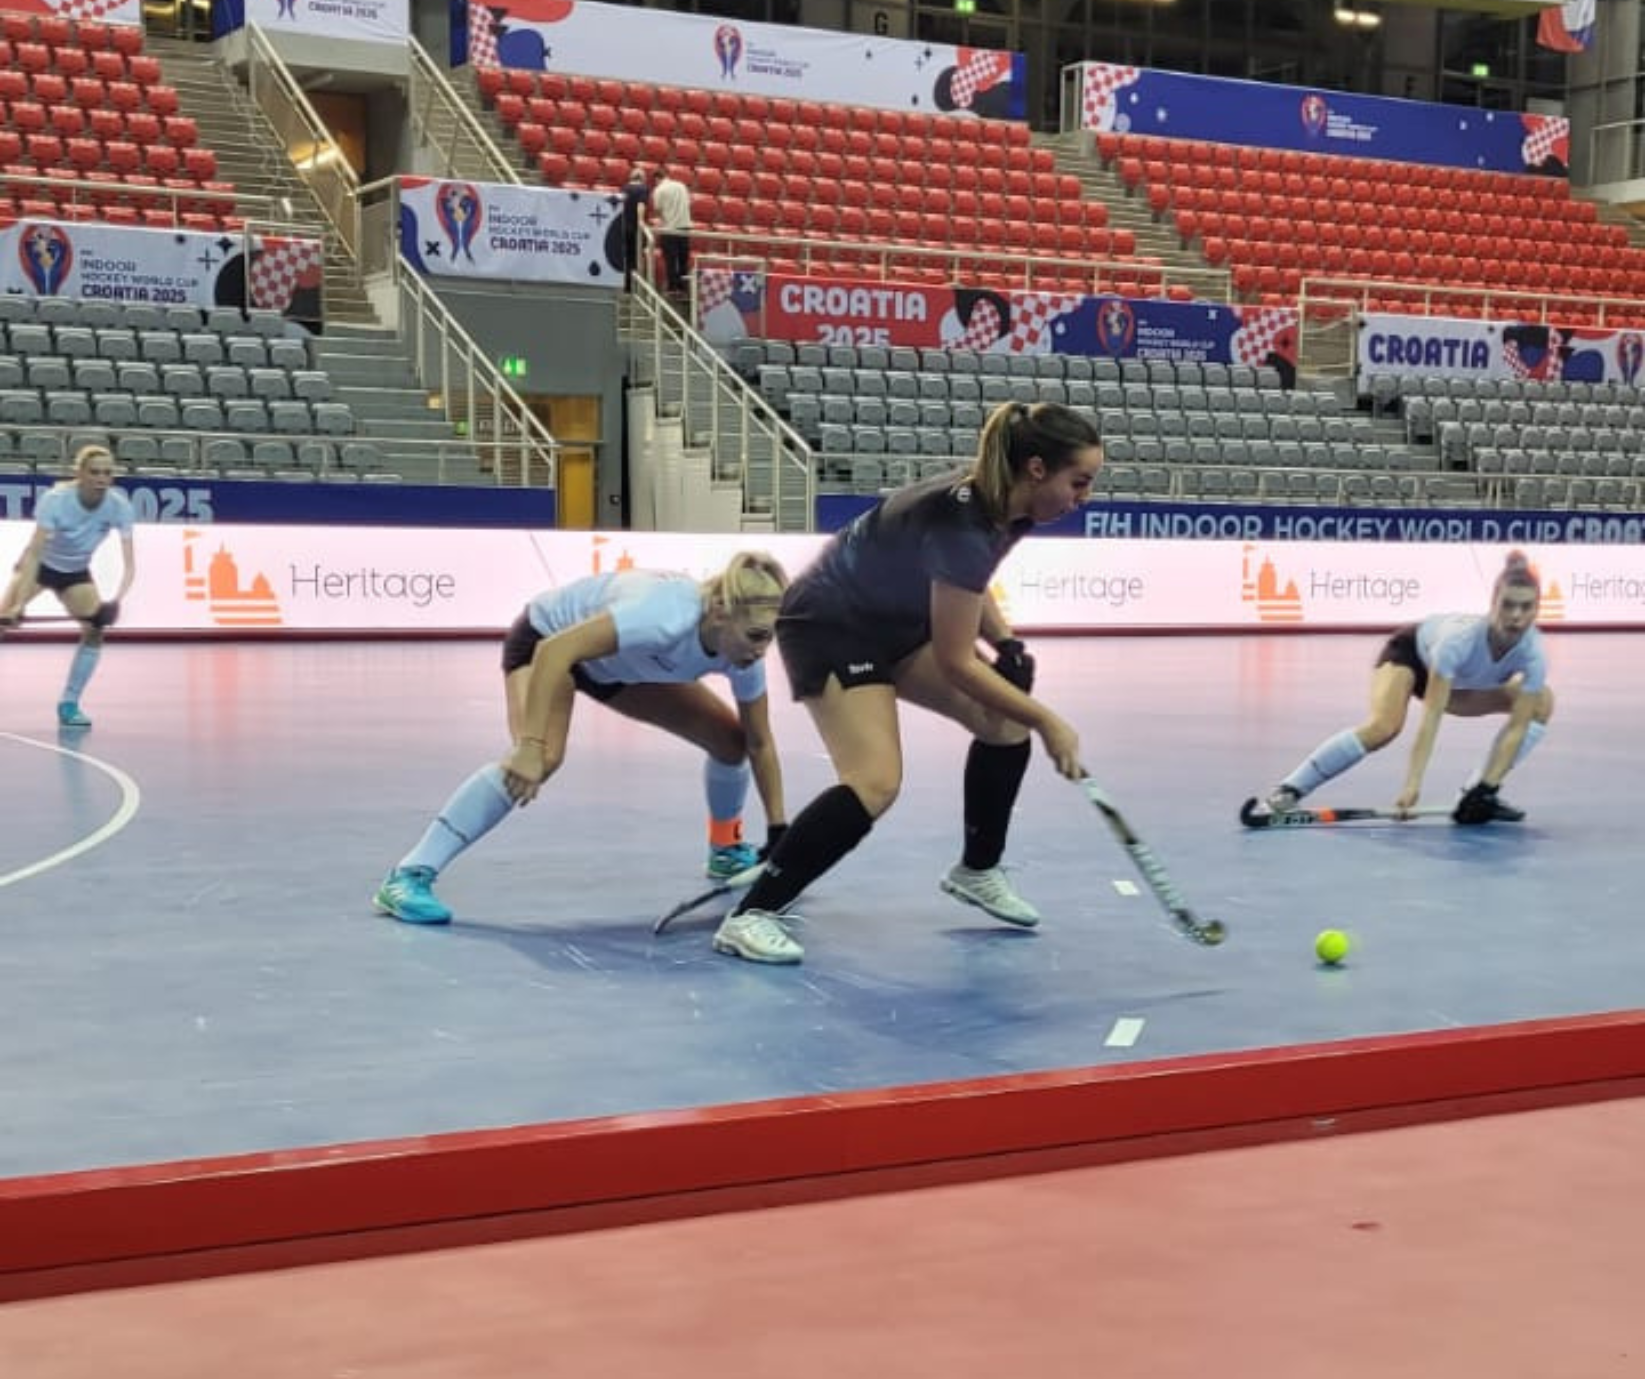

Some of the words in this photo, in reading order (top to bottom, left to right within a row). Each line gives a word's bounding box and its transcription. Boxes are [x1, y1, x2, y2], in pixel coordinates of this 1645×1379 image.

[875, 9, 888, 35] G
[488, 214, 537, 226] INDOOR
[490, 236, 549, 252] CROATIA
[551, 241, 582, 256] 2025
[80, 259, 137, 272] INDOOR
[80, 273, 128, 284] HOCKEY
[176, 278, 199, 288] CUP
[81, 284, 150, 300] CROATIA
[152, 288, 187, 304] 2025
[780, 283, 927, 322] CROATIA
[816, 324, 891, 347] 2025
[1137, 348, 1182, 360] CROATIA
[1368, 333, 1490, 368] CROATIA
[119, 485, 215, 523] 025
[1084, 511, 1133, 539] FIH
[1140, 513, 1264, 540] INDOOR
[1274, 515, 1392, 541] HOCKEY
[1399, 517, 1501, 543] WORLD
[1507, 519, 1562, 543] CUP
[1565, 517, 1645, 545] CROA
[289, 563, 457, 608] Heritage
[1020, 569, 1145, 607] Heritage
[1309, 567, 1422, 606] Heritage
